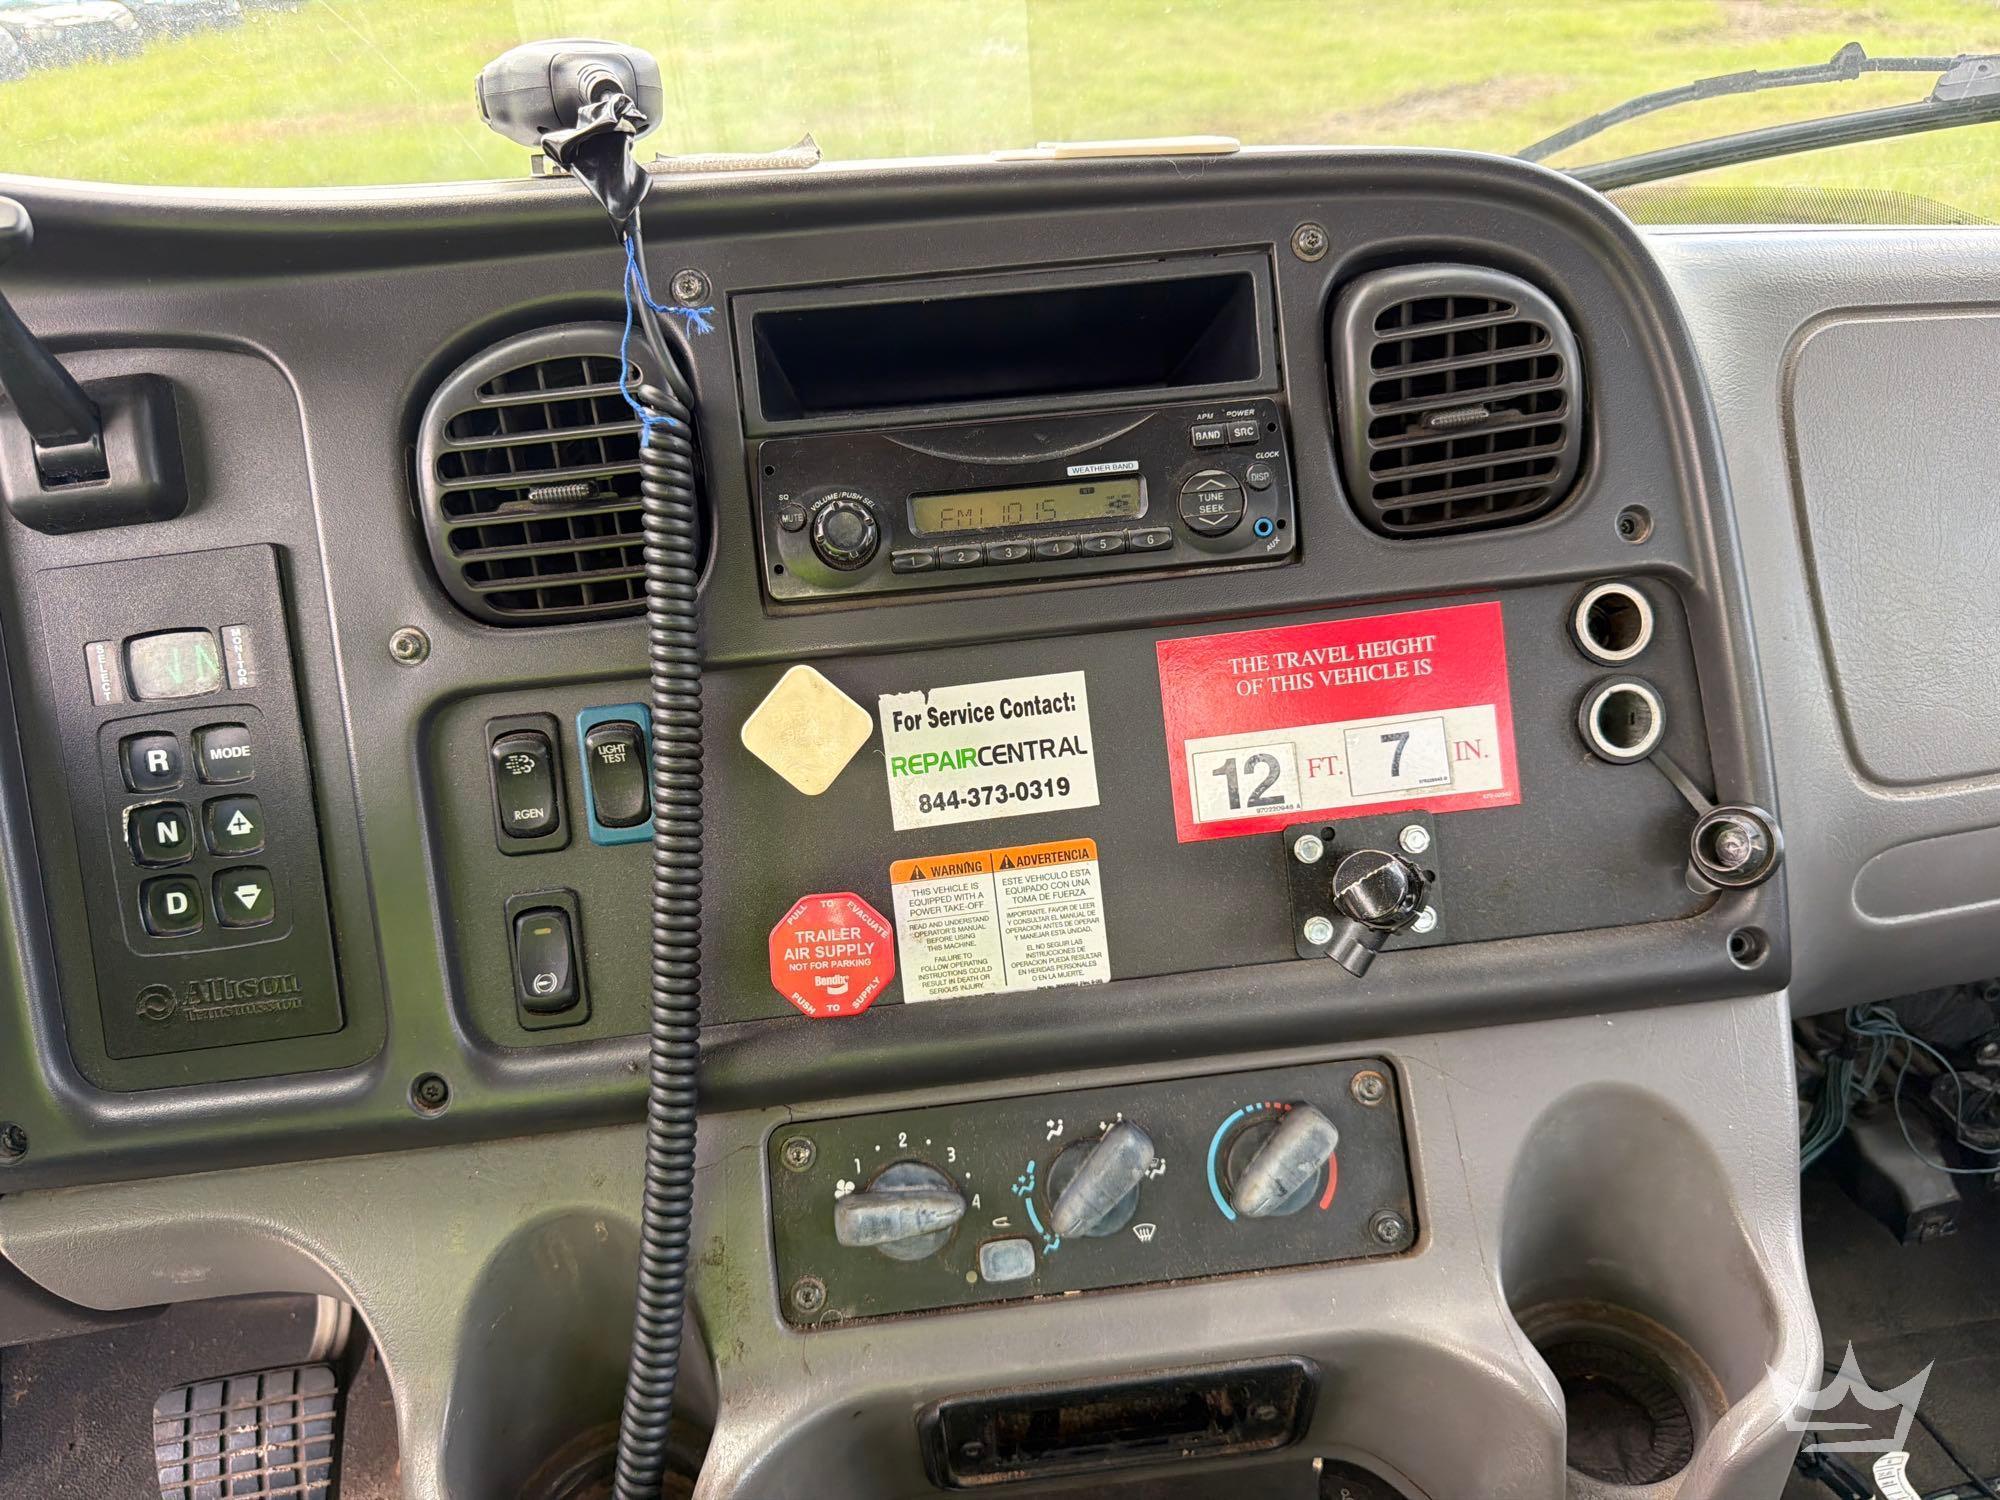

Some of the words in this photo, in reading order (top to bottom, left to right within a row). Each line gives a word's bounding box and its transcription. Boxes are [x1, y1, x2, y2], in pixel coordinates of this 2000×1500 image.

[1227, 409, 1255, 417] POWER
[1196, 431, 1220, 440] BAND
[1234, 427, 1254, 437] SRC
[1256, 451, 1279, 459] CLOCK
[1072, 465, 1110, 473] WEATHER
[1251, 472, 1269, 481] DISP
[1199, 492, 1224, 502] TUNE
[1199, 504, 1224, 513] SEEK
[782, 514, 803, 522] MUTE
[1100, 539, 1107, 549] 5
[1147, 535, 1154, 545] 6
[1266, 536, 1280, 551] AUX
[1005, 548, 1012, 558] 3
[1053, 544, 1059, 553] 4
[910, 556, 915, 566] 1
[957, 552, 965, 562] 2
[231, 628, 248, 685] MONITOR
[1228, 657, 1269, 675] THE
[1272, 646, 1354, 669] TRAVEL
[1357, 635, 1435, 660] HEIGHT
[96, 644, 112, 701] SELECT
[1236, 679, 1263, 696] OF
[1269, 673, 1314, 693] THIS
[1318, 662, 1409, 686] VEHICLE
[1414, 658, 1433, 675] IS
[893, 711, 921, 732] For
[927, 702, 995, 728] Service
[1000, 692, 1076, 719] Contact:
[210, 746, 250, 760] MODE
[598, 744, 625, 755] LIGHT
[147, 750, 169, 772] R
[603, 754, 626, 764] TEST
[1212, 753, 1285, 810] 12
[1306, 755, 1344, 778] FT.
[1380, 731, 1410, 778] 7
[1455, 739, 1489, 762] IN.
[918, 776, 1070, 814] 844-373-0319
[514, 808, 544, 821] RGEN
[157, 821, 178, 843] N
[1017, 849, 1089, 867] ADVERTENCIA
[931, 861, 982, 877] WARNING
[1002, 877, 1022, 886] ESTE
[1025, 871, 1068, 883] VEHICULO
[1070, 869, 1091, 877] ESTA
[912, 888, 931, 897] THIS
[933, 883, 968, 895] VEHICLE
[1005, 884, 1048, 895] EQUIPADO
[1051, 882, 1069, 890] CON
[1072, 879, 1090, 887] UNA
[166, 892, 188, 915] D
[909, 895, 952, 907] EQUIPPED
[955, 893, 975, 901] WITH
[1013, 895, 1037, 904] TOMA
[1053, 889, 1086, 899] FUERZA
[910, 905, 941, 917] POWER
[943, 901, 984, 913] TAKE-OFF
[1049, 905, 1068, 913] FAVOR
[787, 905, 807, 925] PULL
[821, 900, 834, 908] TO
[847, 901, 889, 939] EVACUATE
[929, 920, 943, 928] AND
[945, 915, 989, 927] UNDERSTAND
[1013, 915, 1050, 925] CONSULTAR
[1060, 911, 1085, 919] MANUAL
[914, 927, 956, 938] OPERATOR'S
[958, 924, 986, 933] MANUAL
[1006, 924, 1042, 934] OPERACION
[1043, 922, 1063, 930] ANTES
[1074, 917, 1100, 926] OPERAR
[795, 927, 861, 944] TRAILER
[927, 935, 952, 944] BEFORE
[1020, 931, 1049, 940] MANEJAR
[1051, 929, 1065, 937] ESTA
[784, 947, 810, 960] AIR
[816, 942, 875, 958] SUPPLY
[927, 944, 942, 952] THIS
[1047, 940, 1069, 948] SEGUIR
[935, 953, 962, 963] FAILURE
[1011, 958, 1047, 968] OPERACION
[1049, 956, 1069, 964] PUEDA
[1071, 952, 1102, 961] RESULTAR
[1026, 948, 1075, 958] INSTRUCCIONES
[789, 963, 807, 971] NOT
[810, 961, 829, 969] FOR
[831, 958, 871, 968] PARKING
[921, 964, 948, 972] FOLLOW
[950, 959, 988, 969] OPERATING
[1028, 965, 1054, 974] HERIDAS
[1056, 960, 1097, 970] PERSONALES
[918, 970, 967, 980] INSTRUCTIONS
[922, 979, 947, 988] RESULT
[958, 976, 979, 984] DEATH
[183, 975, 300, 1006] Allison
[792, 992, 816, 1014] PUSH
[826, 1004, 840, 1012] TO
[852, 976, 880, 1009] SUPPLY
[929, 986, 958, 995] SERIOUS
[899, 1132, 907, 1147] 2
[947, 1146, 956, 1162] 3
[854, 1158, 860, 1174] 1
[972, 1193, 981, 1210] 4
